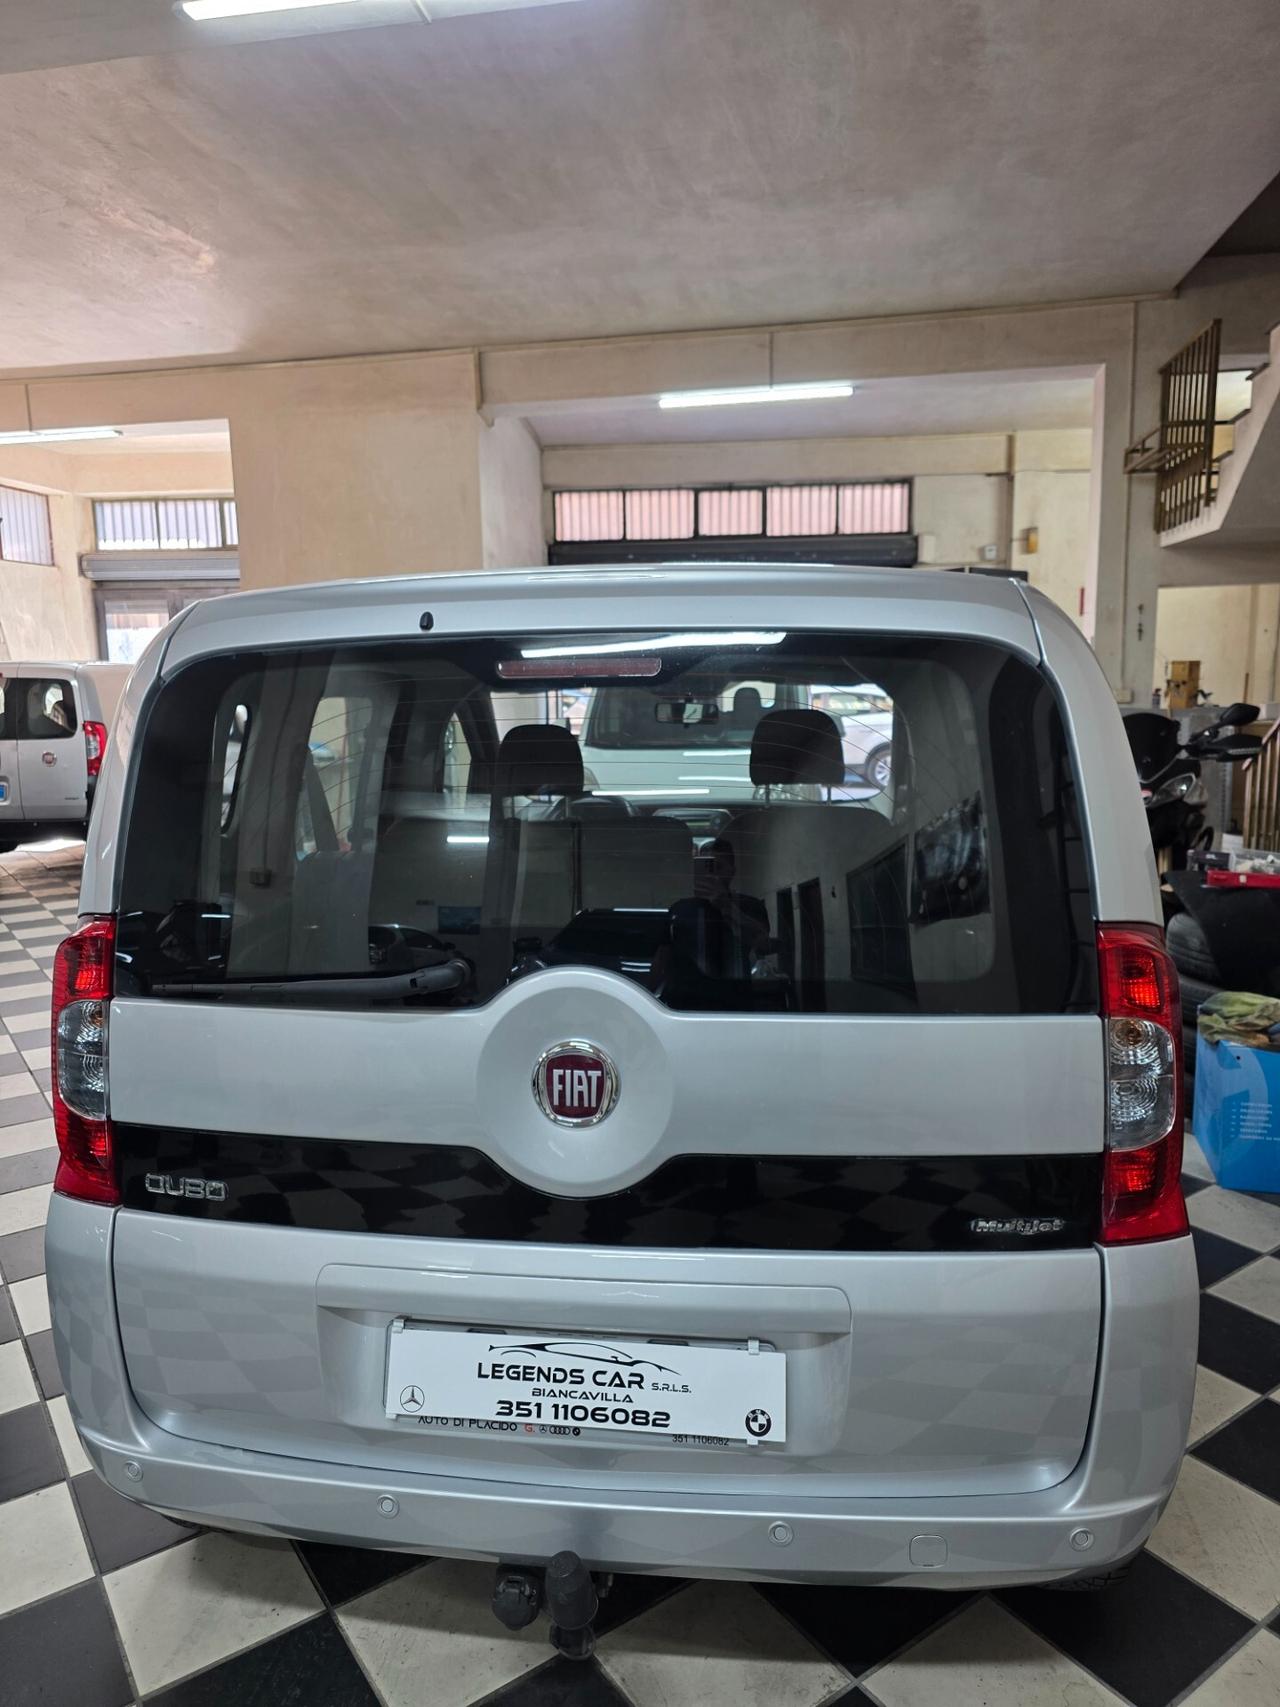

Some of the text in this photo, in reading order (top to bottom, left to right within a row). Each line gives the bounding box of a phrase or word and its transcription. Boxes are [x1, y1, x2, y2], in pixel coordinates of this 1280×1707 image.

[553, 1069, 602, 1108] FIAT
[145, 1173, 229, 1201] QUBO
[477, 1362, 692, 1393] LEGENDS CAR S.R.L.S.
[531, 1387, 634, 1403] BIANCAVILLA
[418, 1416, 449, 1425] AUTO
[453, 1417, 464, 1427] DI
[469, 1418, 518, 1431] PLACIDO
[495, 1400, 671, 1428] 351 1106082
